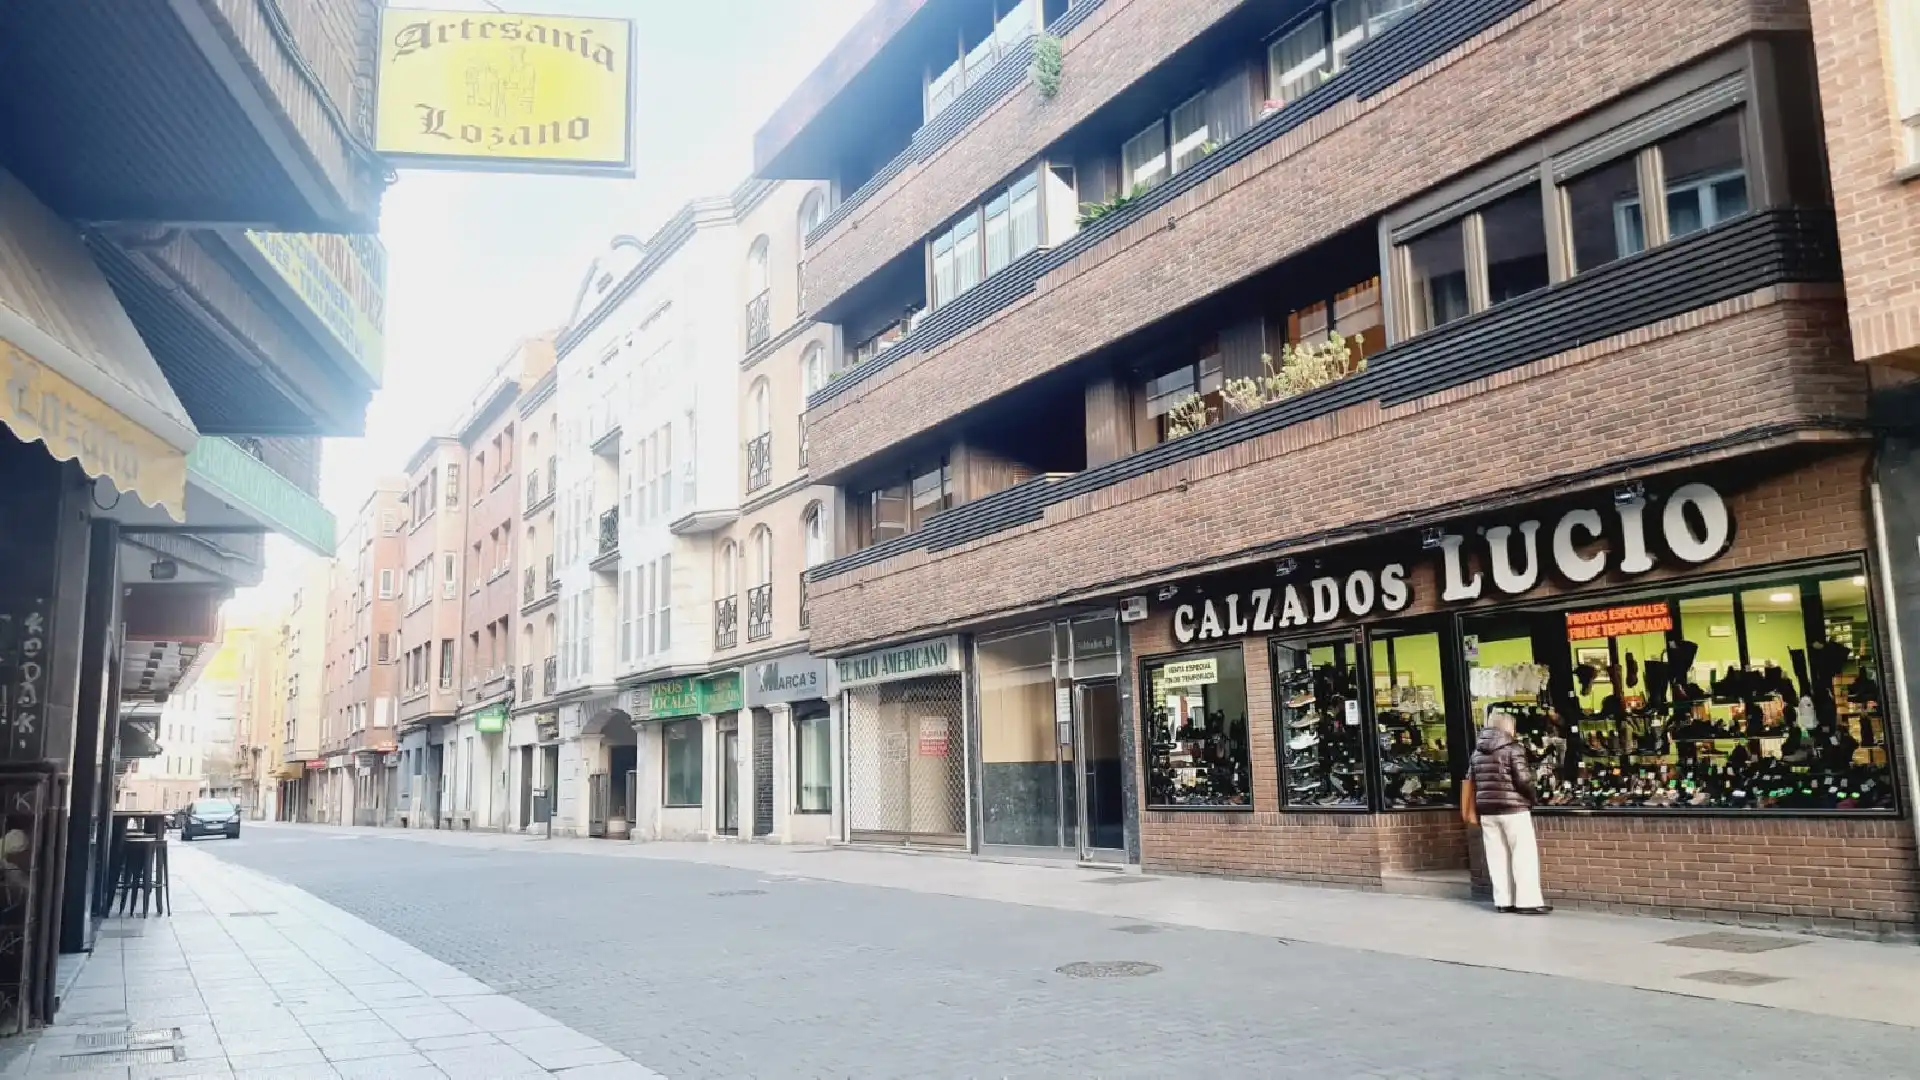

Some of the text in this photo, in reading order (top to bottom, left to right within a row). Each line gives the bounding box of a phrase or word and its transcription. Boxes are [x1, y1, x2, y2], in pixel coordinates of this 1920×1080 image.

[392, 18, 614, 72] Artesanía
[415, 103, 589, 151] Lozano
[1174, 482, 1728, 643] CALZADOS LUCIO
[1609, 603, 1668, 620] ESPECIALES
[854, 655, 878, 680] KILO
[881, 642, 948, 676] AMERICANO
[649, 693, 698, 711] LOCALES
[652, 676, 696, 695] PISOS Y
